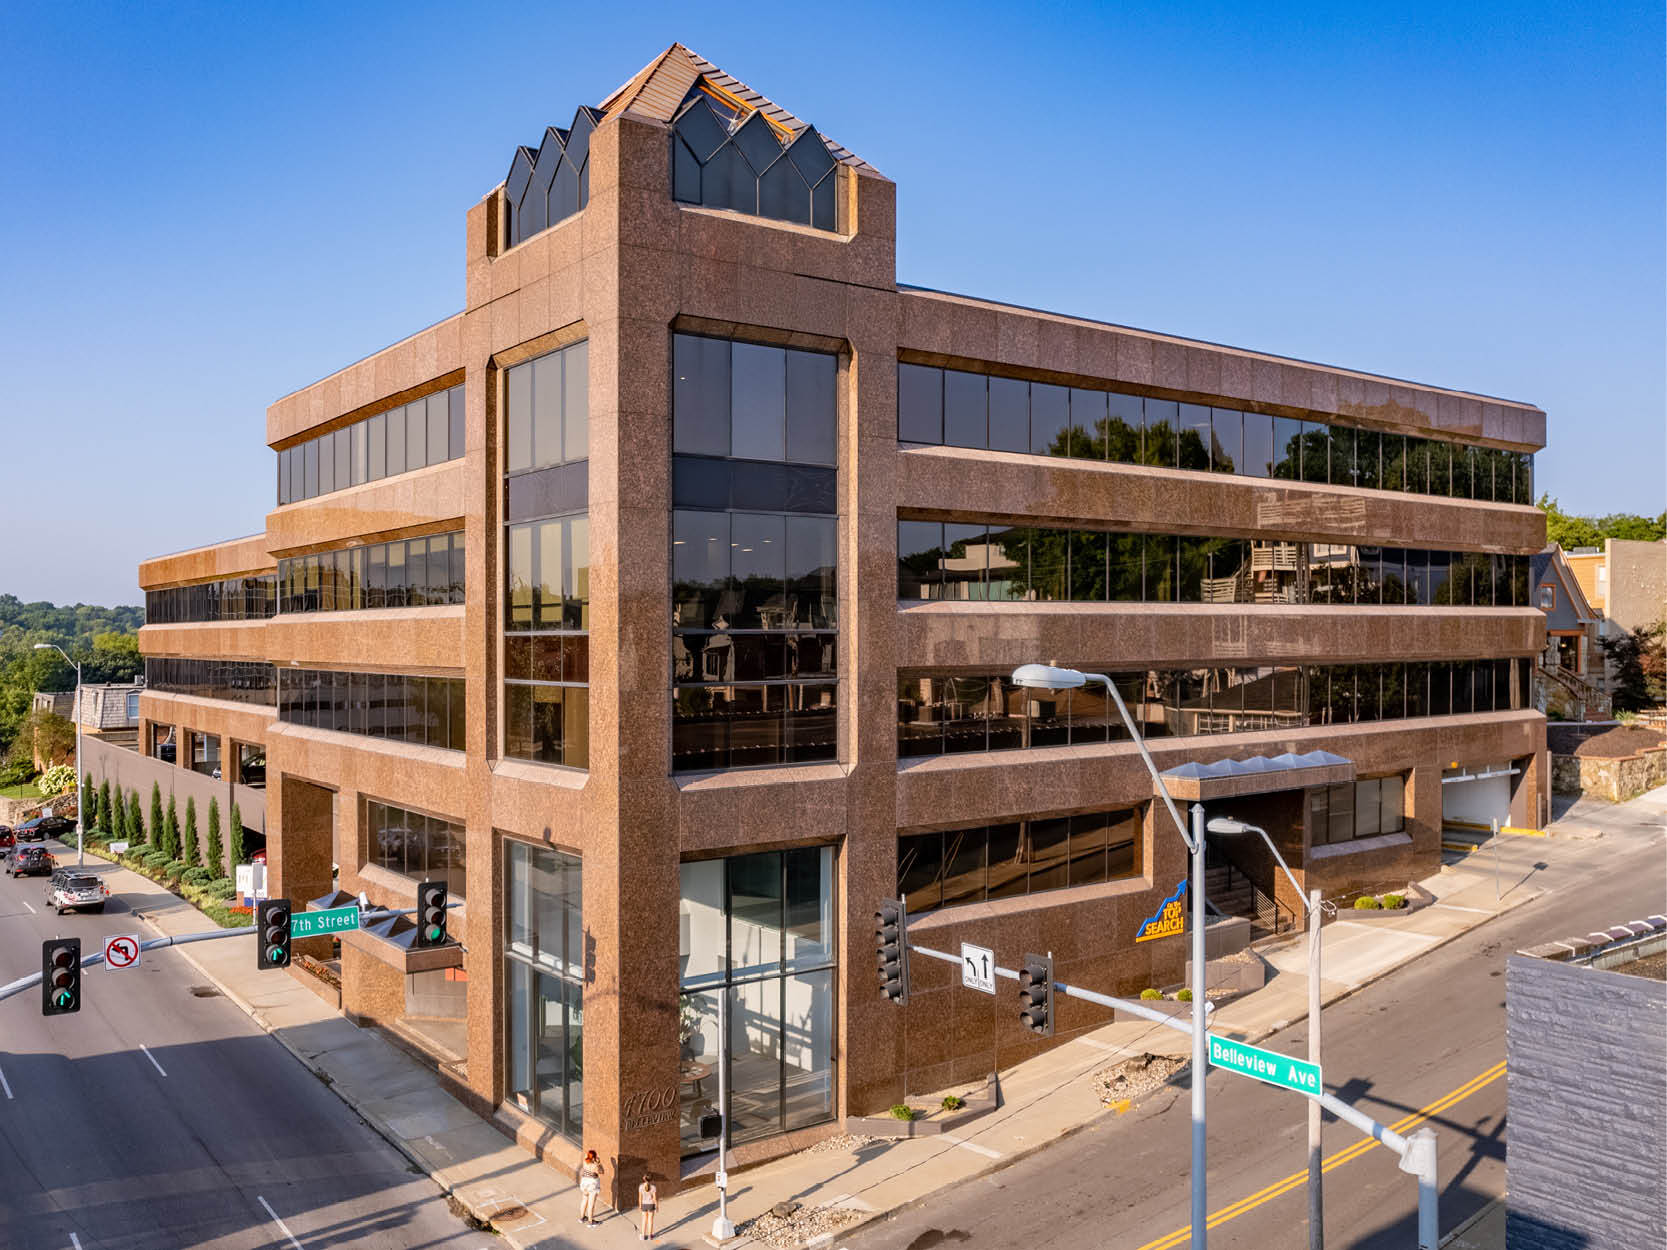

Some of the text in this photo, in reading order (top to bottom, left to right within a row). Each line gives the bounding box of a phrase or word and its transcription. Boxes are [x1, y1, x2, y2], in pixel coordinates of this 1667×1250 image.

[291, 912, 355, 933] 7th Street
[1145, 917, 1183, 935] SEARCH
[1213, 1042, 1316, 1087] Belleview Ave
